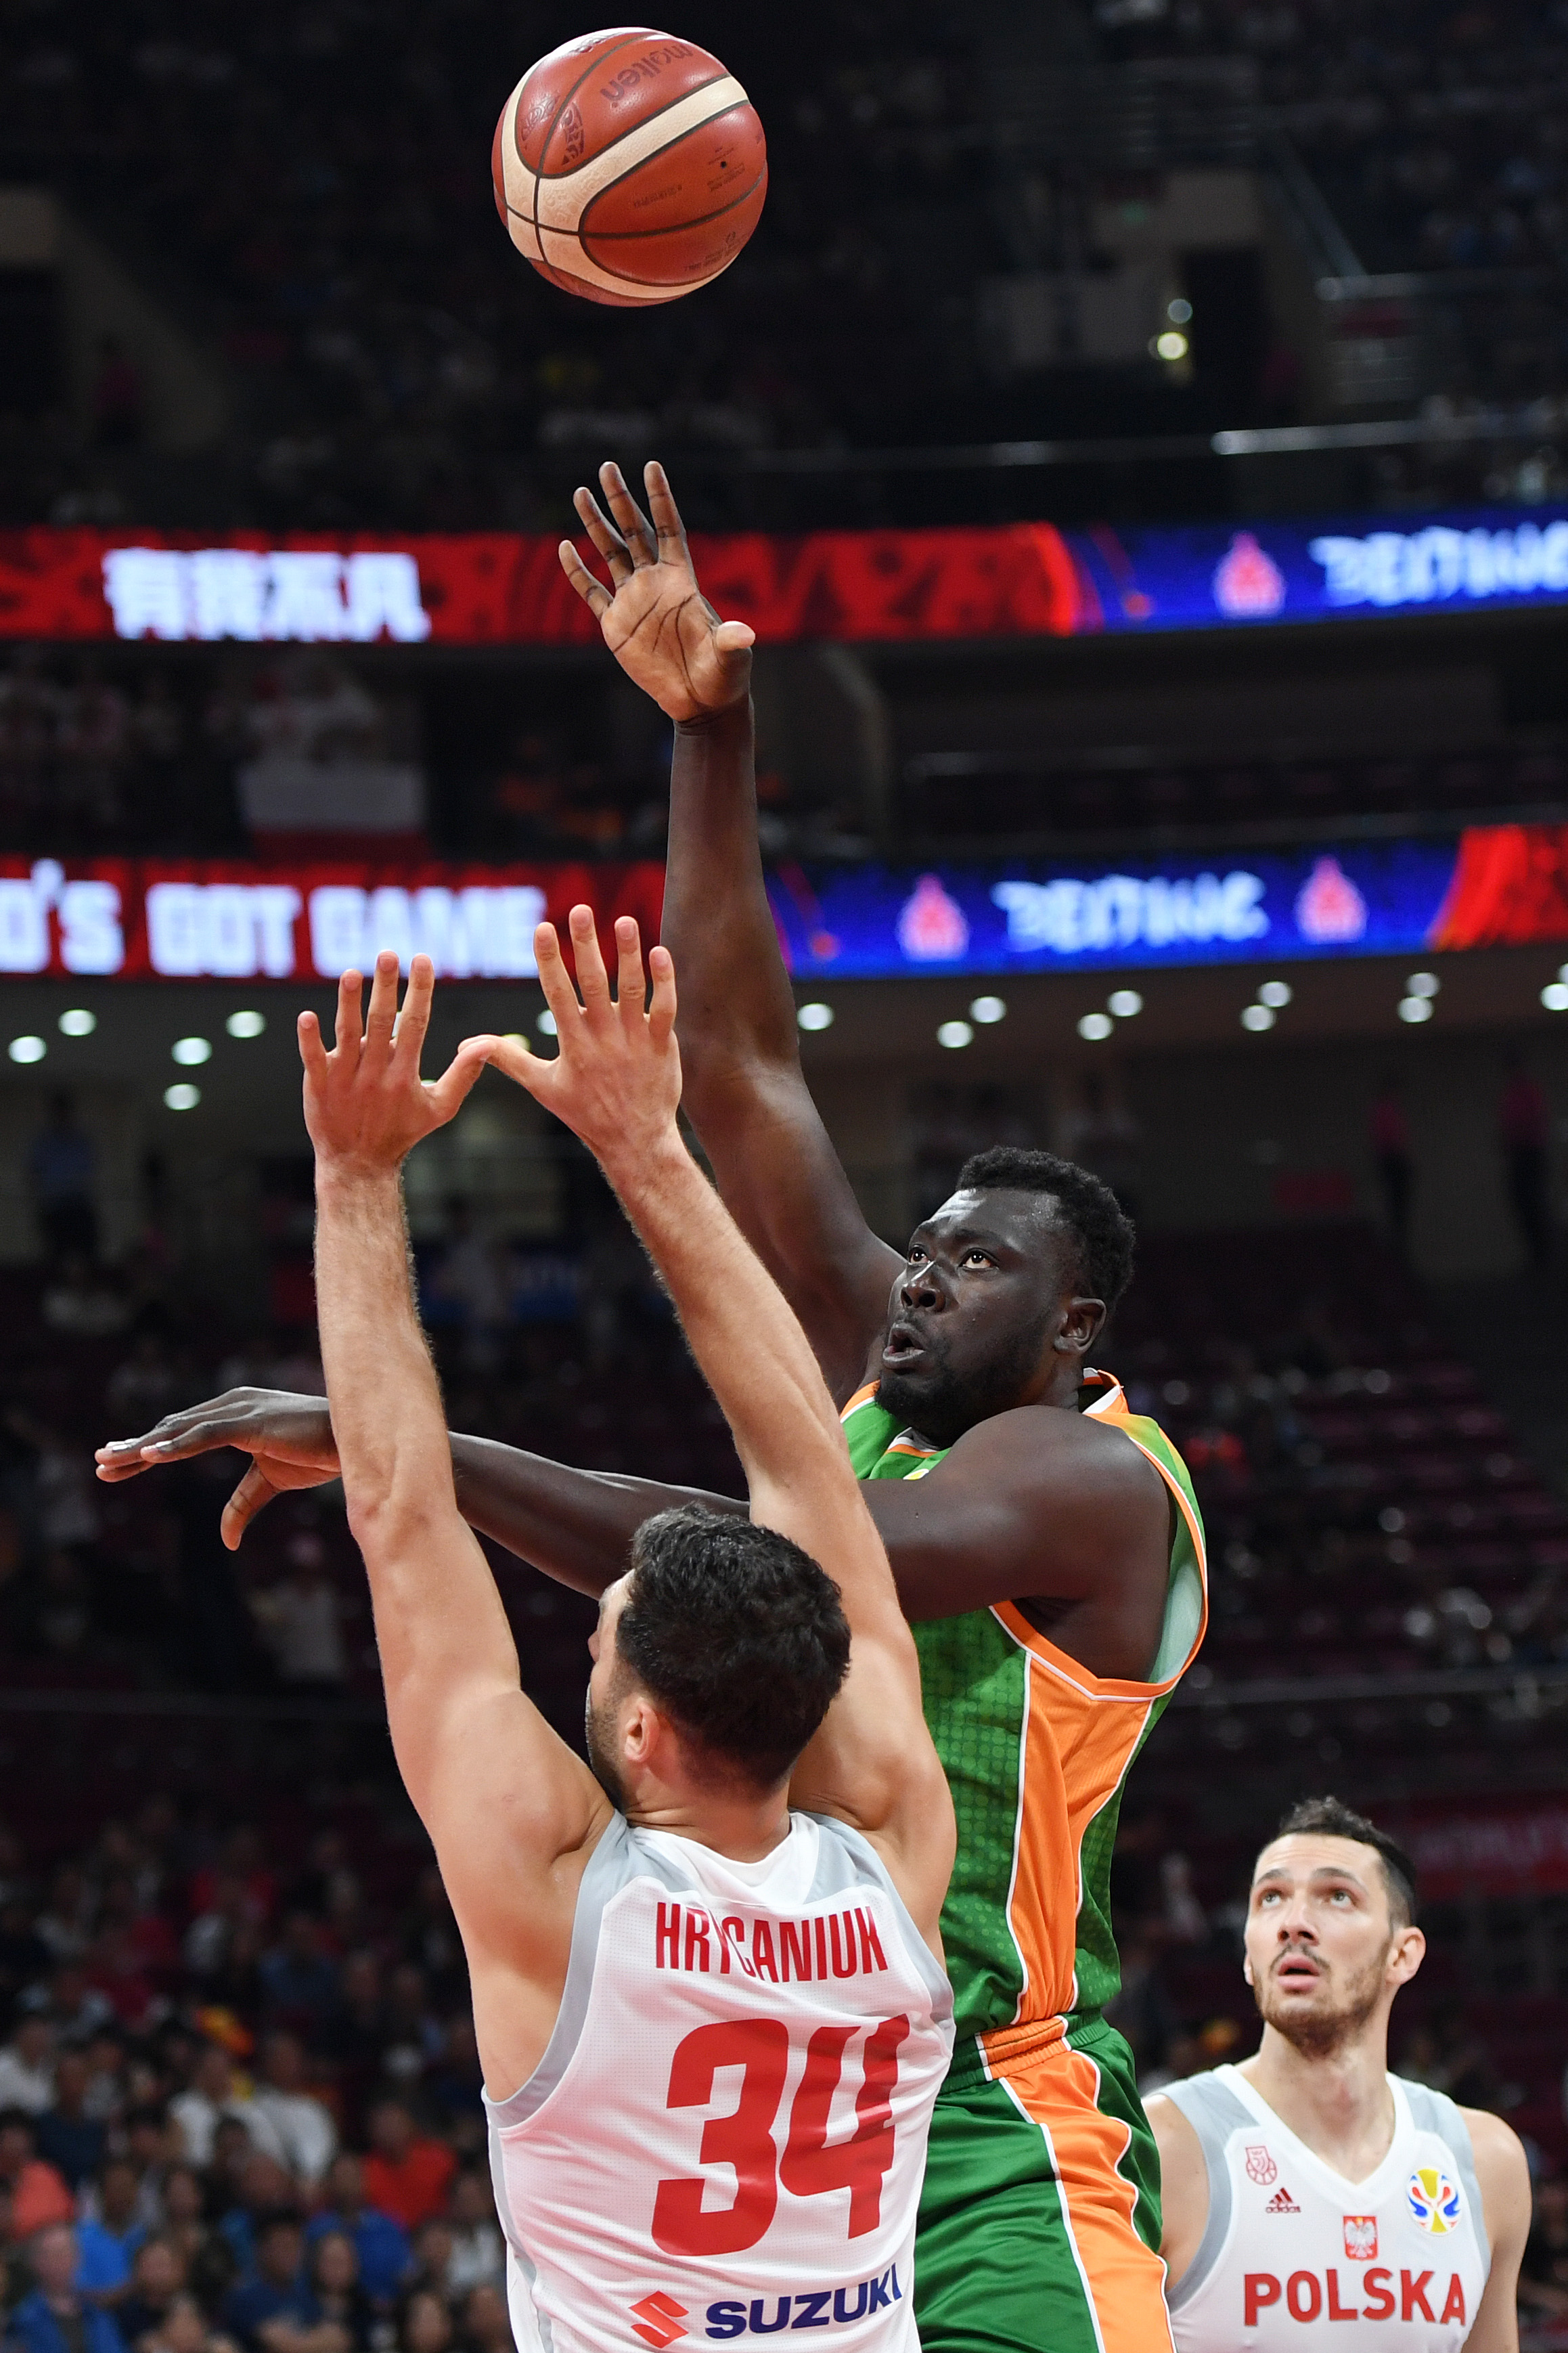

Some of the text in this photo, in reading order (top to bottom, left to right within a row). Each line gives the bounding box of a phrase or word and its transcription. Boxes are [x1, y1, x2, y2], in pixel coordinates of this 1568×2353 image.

[600, 43, 694, 101] molten
[147, 883, 300, 977] GOT
[309, 886, 544, 979] GAME
[655, 1901, 889, 1983] HRYCANIUK
[651, 2013, 911, 2256] 34
[1265, 2203, 1301, 2214] adidas
[704, 2262, 903, 2339] SUZUKI
[1244, 2267, 1466, 2327] POLSKA
